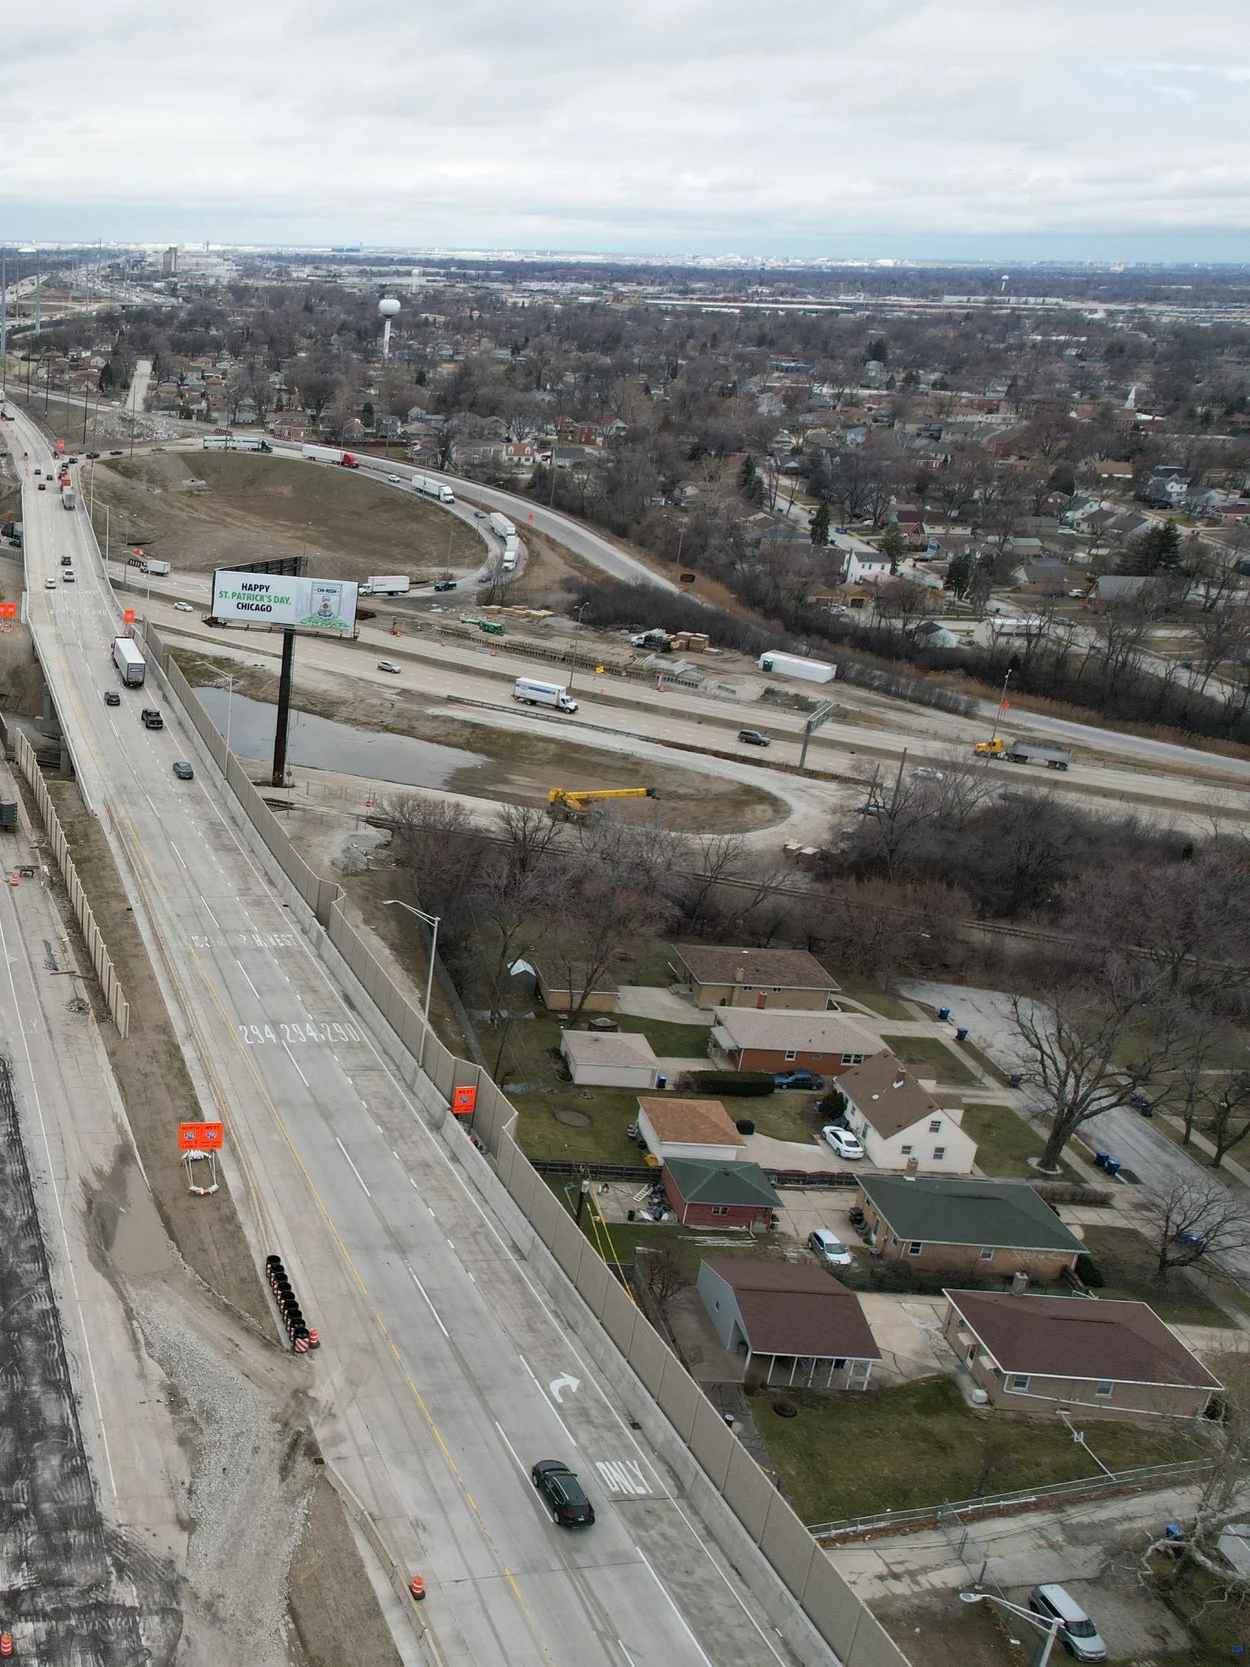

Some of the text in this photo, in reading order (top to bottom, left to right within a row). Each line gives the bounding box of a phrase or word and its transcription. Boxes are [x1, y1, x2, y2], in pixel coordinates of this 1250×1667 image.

[241, 583, 270, 593] HAPPY
[218, 590, 291, 605] ST. PATRICK'S DAY,
[236, 602, 272, 612] CHICAGO
[238, 1022, 361, 1044] 294 294 290
[596, 1460, 653, 1494] ONLY
